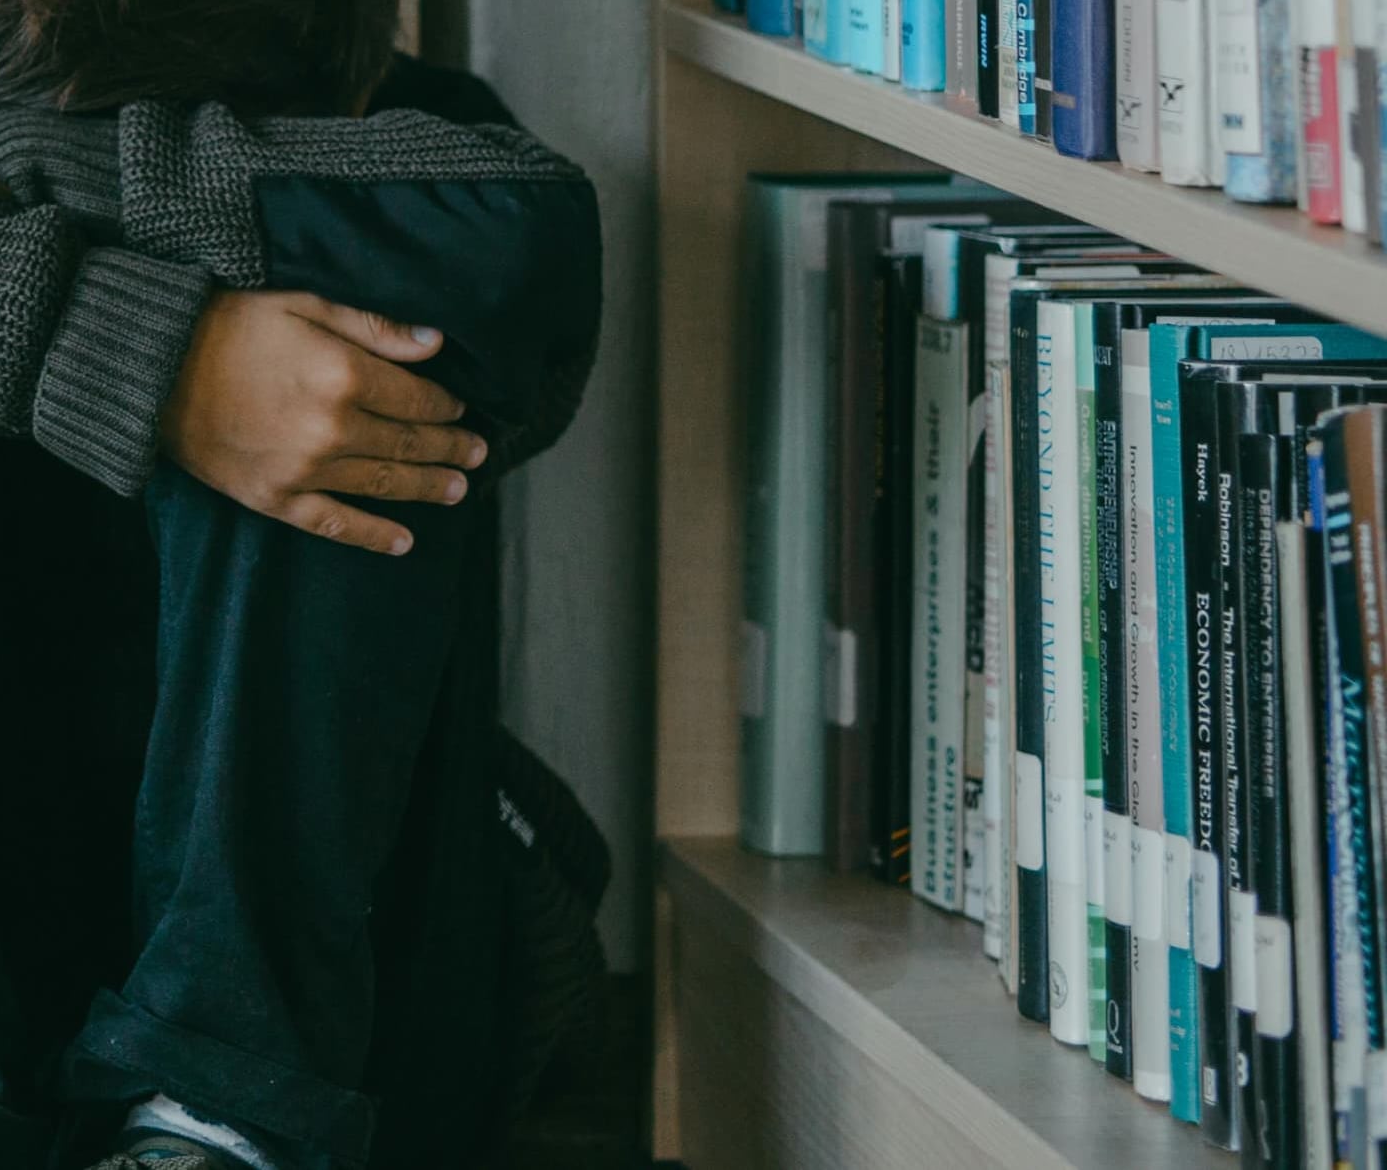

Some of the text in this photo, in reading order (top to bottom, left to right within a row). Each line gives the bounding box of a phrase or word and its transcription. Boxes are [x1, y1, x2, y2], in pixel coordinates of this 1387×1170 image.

[980, 13, 988, 68] IRWIN
[1017, 2, 1028, 104] Cambridge
[926, 402, 941, 481] their
[1103, 420, 1118, 589] ENTREPRENEURSHIP
[1037, 332, 1057, 725] BEYOND THE LIMITS
[1129, 444, 1140, 773] Innovation and Growth in the
[1259, 488, 1273, 629] DEPENDENCY
[925, 530, 941, 724] enterprises
[1195, 443, 1212, 853] Hayek ECONOMIC FREEDO
[1219, 473, 1241, 880] Robinson The International Transfer of
[1261, 635, 1273, 669] TO
[924, 735, 939, 894] Business
[943, 745, 957, 905] structure
